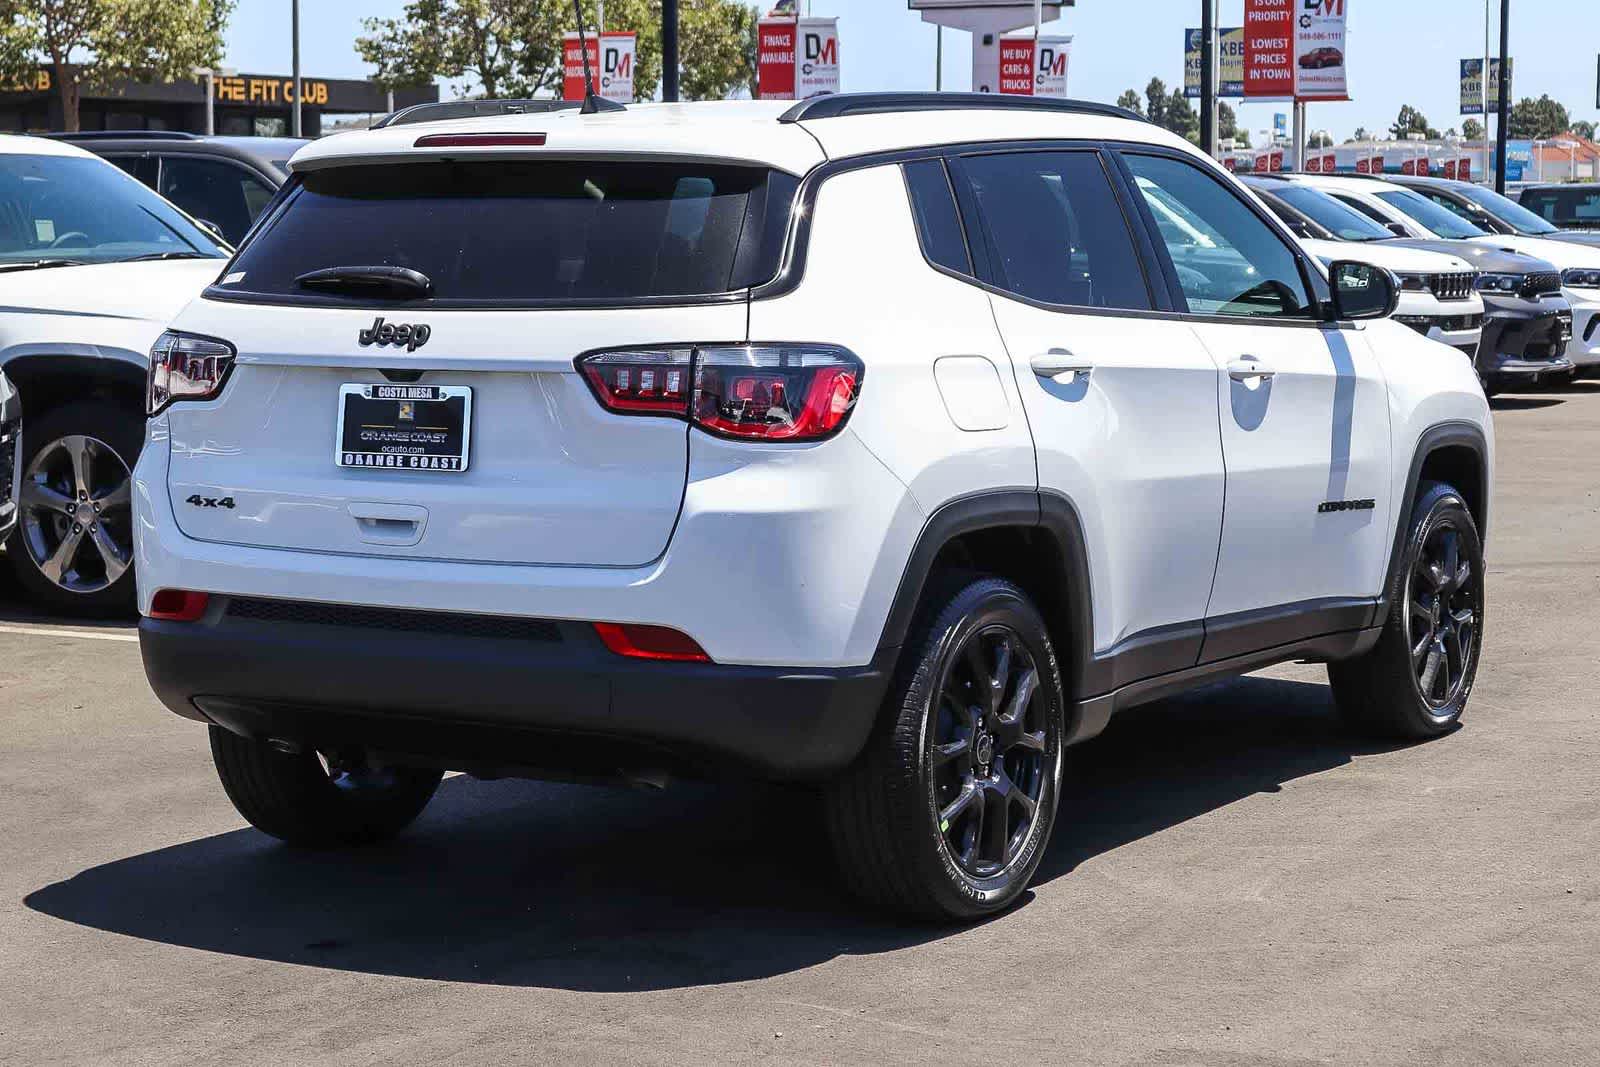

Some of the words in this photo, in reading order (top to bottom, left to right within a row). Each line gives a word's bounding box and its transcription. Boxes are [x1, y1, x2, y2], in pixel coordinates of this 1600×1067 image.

[1248, 11, 1291, 21] PRIORITY
[764, 34, 791, 47] FINANCE
[1251, 39, 1289, 49] LOWEST
[761, 52, 795, 65] AVAILABLE
[1003, 48, 1014, 60] WE
[1015, 48, 1032, 60] BUY
[1254, 54, 1287, 65] PRICES
[1004, 64, 1022, 75] CARS
[1023, 65, 1030, 75] &
[1250, 69, 1260, 80] IN
[1262, 69, 1291, 80] TOWN
[1003, 80, 1031, 89] TRUCKS
[250, 79, 279, 101] FIT
[283, 81, 328, 104] CUB
[359, 317, 431, 353] Jeep
[378, 386, 407, 398] COSTA
[408, 387, 432, 399] MESA
[360, 431, 410, 443] ORANGE
[411, 433, 448, 444] COAST
[381, 445, 425, 455] ocauto.com
[345, 453, 404, 467] ORANGE
[410, 456, 459, 469] COAST
[185, 495, 236, 509] 4x4
